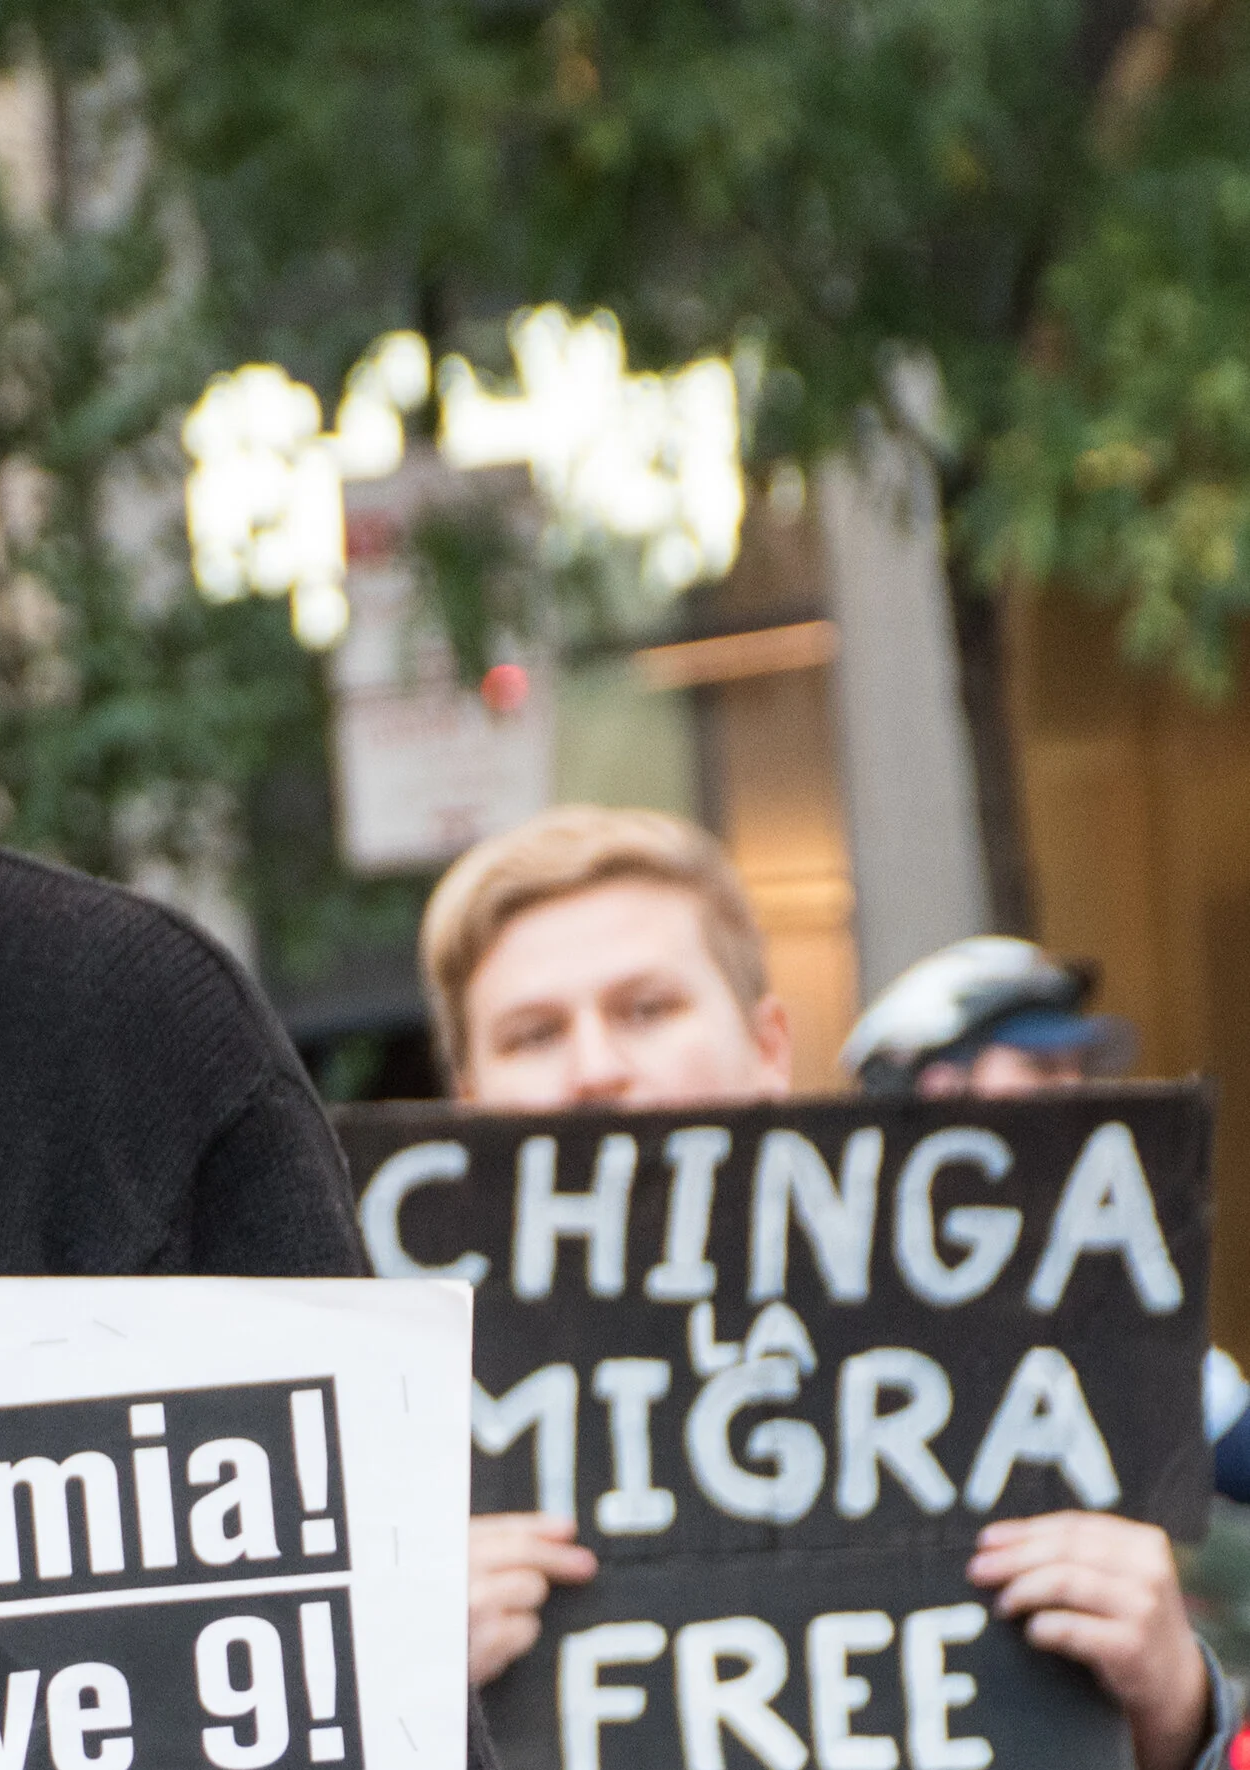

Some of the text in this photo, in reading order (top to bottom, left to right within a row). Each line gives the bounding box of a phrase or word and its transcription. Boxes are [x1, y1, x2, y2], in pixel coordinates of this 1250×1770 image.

[358, 1120, 1183, 1314] CHINGA
[688, 1302, 817, 1377] LA
[472, 1345, 1121, 1535] MIGRA
[194, 1602, 345, 1770] 9!
